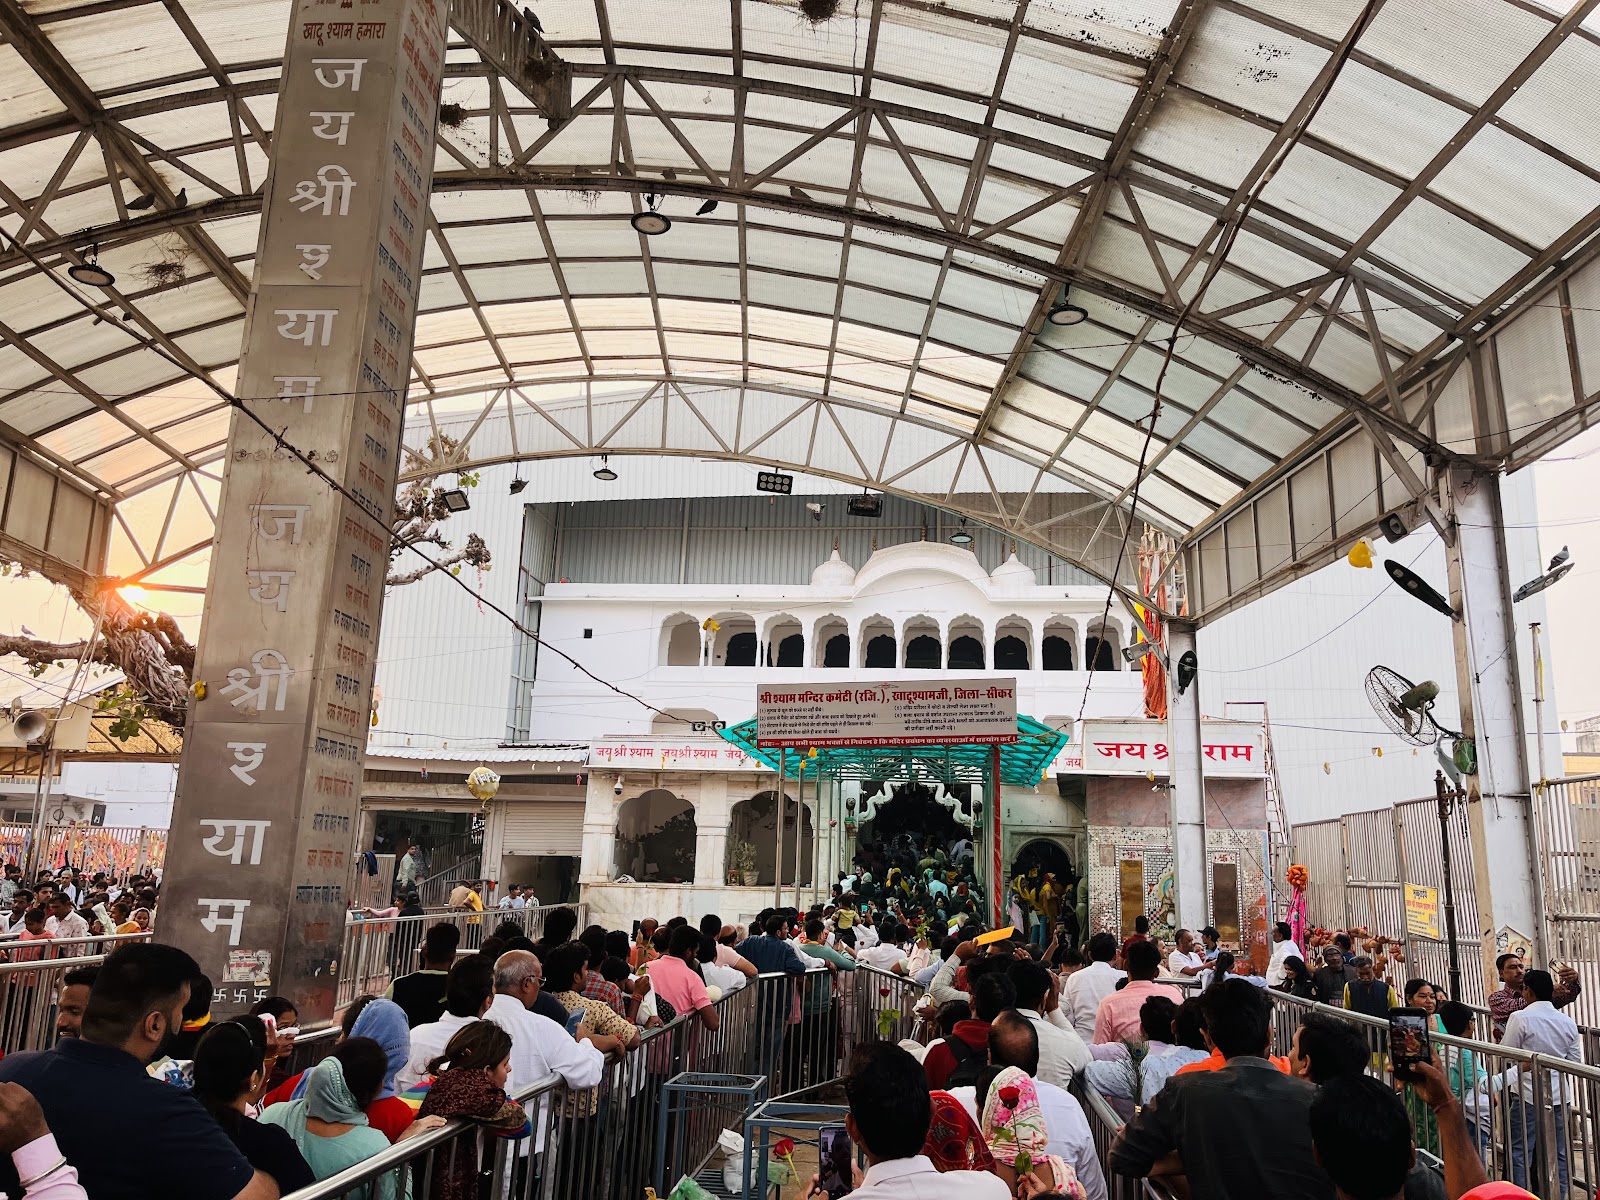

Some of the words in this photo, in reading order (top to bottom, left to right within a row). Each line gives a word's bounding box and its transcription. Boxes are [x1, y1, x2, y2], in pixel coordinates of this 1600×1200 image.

[303, 23, 324, 47] खाटू
[327, 23, 354, 40] श्याम
[356, 23, 386, 41] हमारा
[759, 691, 772, 704] श्री
[773, 692, 796, 704] श्याम
[798, 690, 823, 703] मन्दिर
[825, 690, 852, 703] कमेटी
[629, 748, 655, 759] श्याम
[693, 748, 718, 759] श्याम
[1093, 742, 1148, 761] जय
[1202, 744, 1254, 762] राम
[1065, 757, 1082, 768] जय
